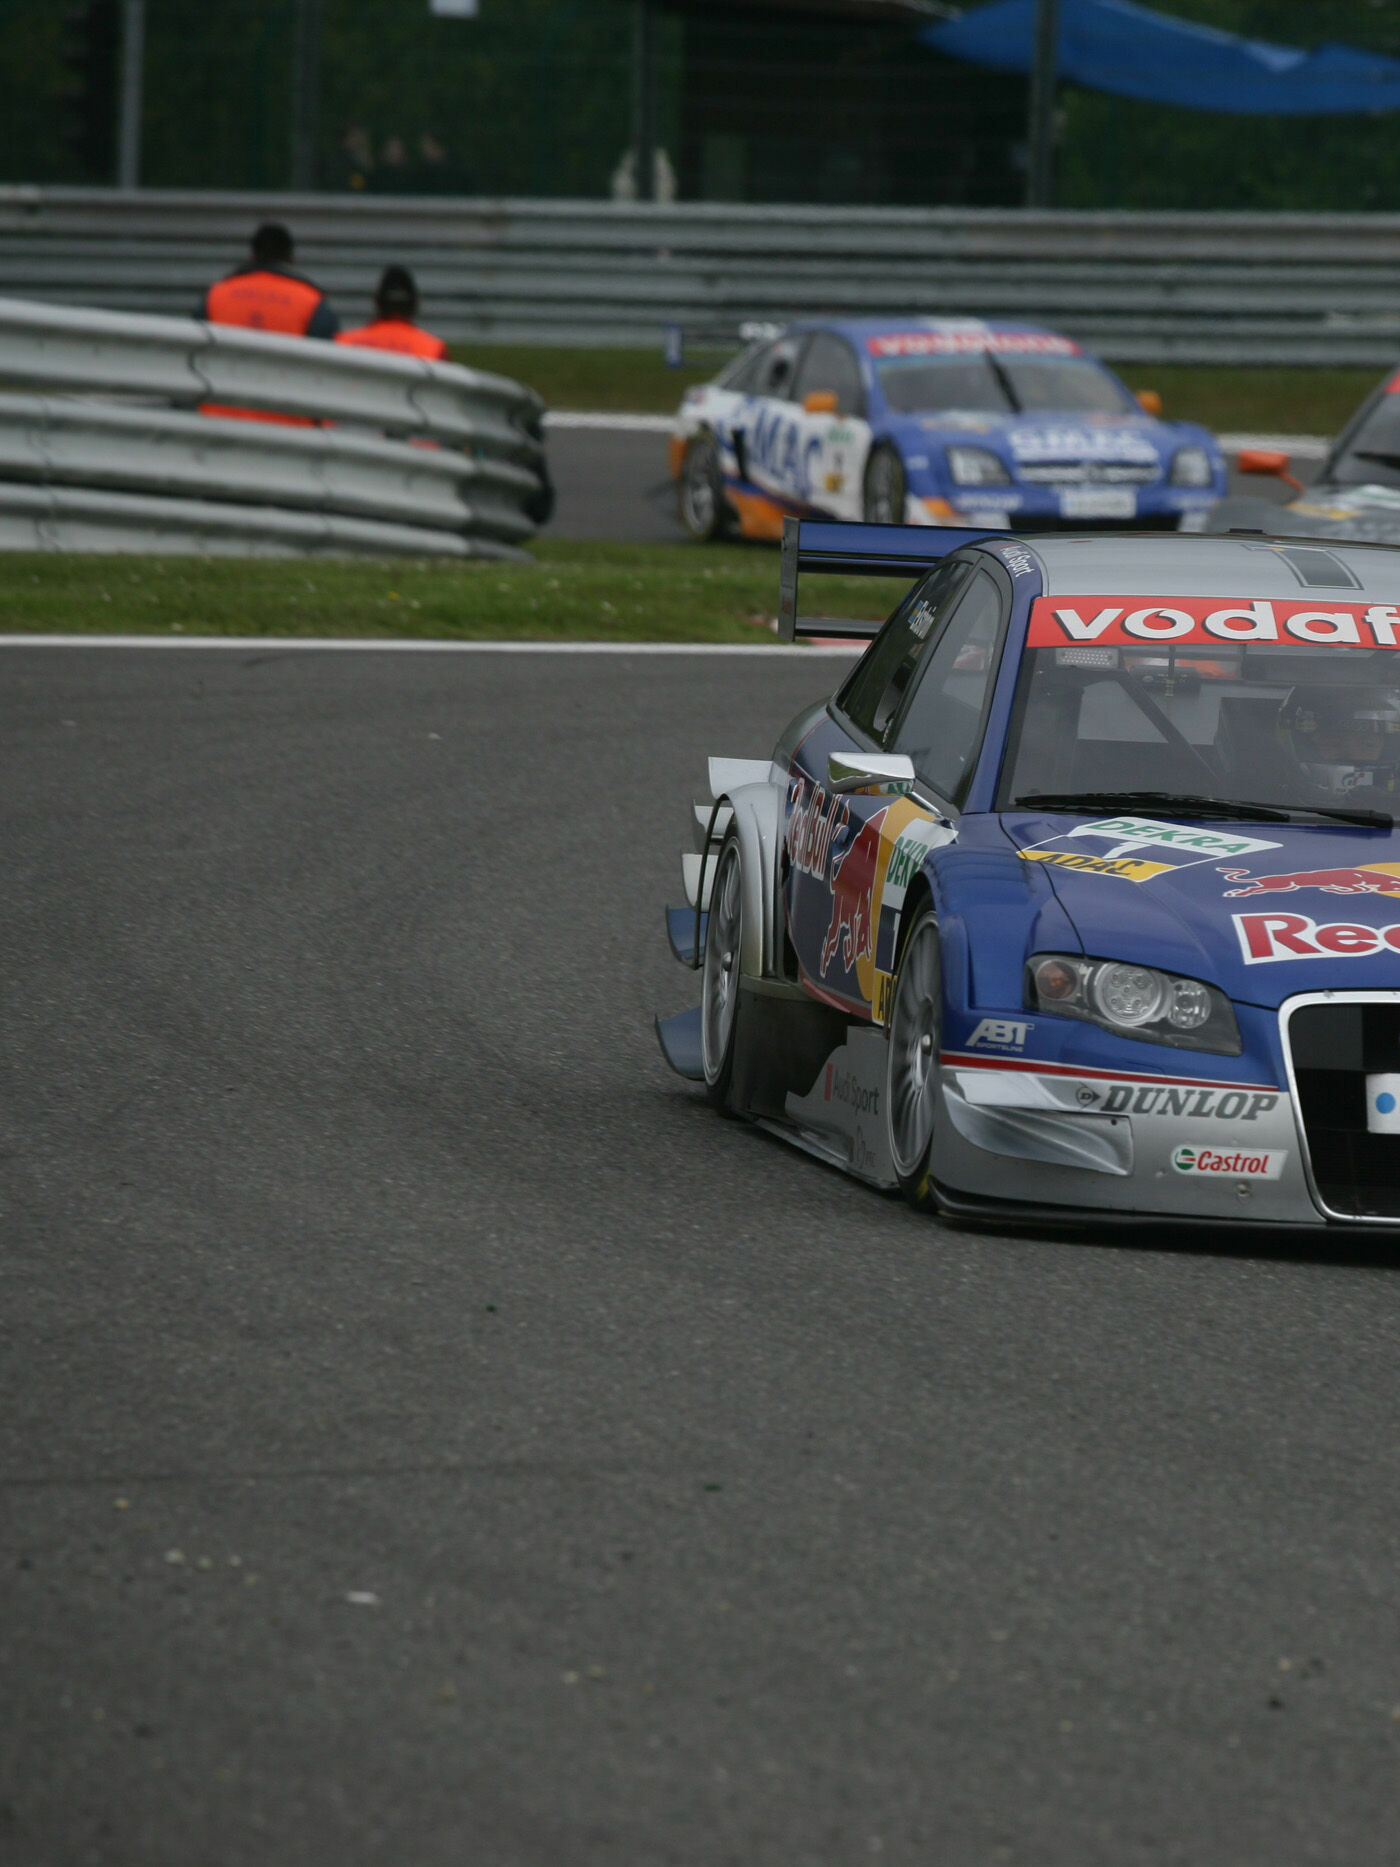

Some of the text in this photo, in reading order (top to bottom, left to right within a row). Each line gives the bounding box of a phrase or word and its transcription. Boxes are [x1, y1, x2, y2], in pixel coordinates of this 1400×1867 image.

[1006, 554, 1035, 577] Sport
[1086, 820, 1252, 854] DEKRA
[1037, 853, 1146, 876] ADAC
[965, 1018, 1026, 1046] ABT
[1101, 1085, 1279, 1121] DUNLOP
[1197, 1151, 1269, 1174] Castrol
